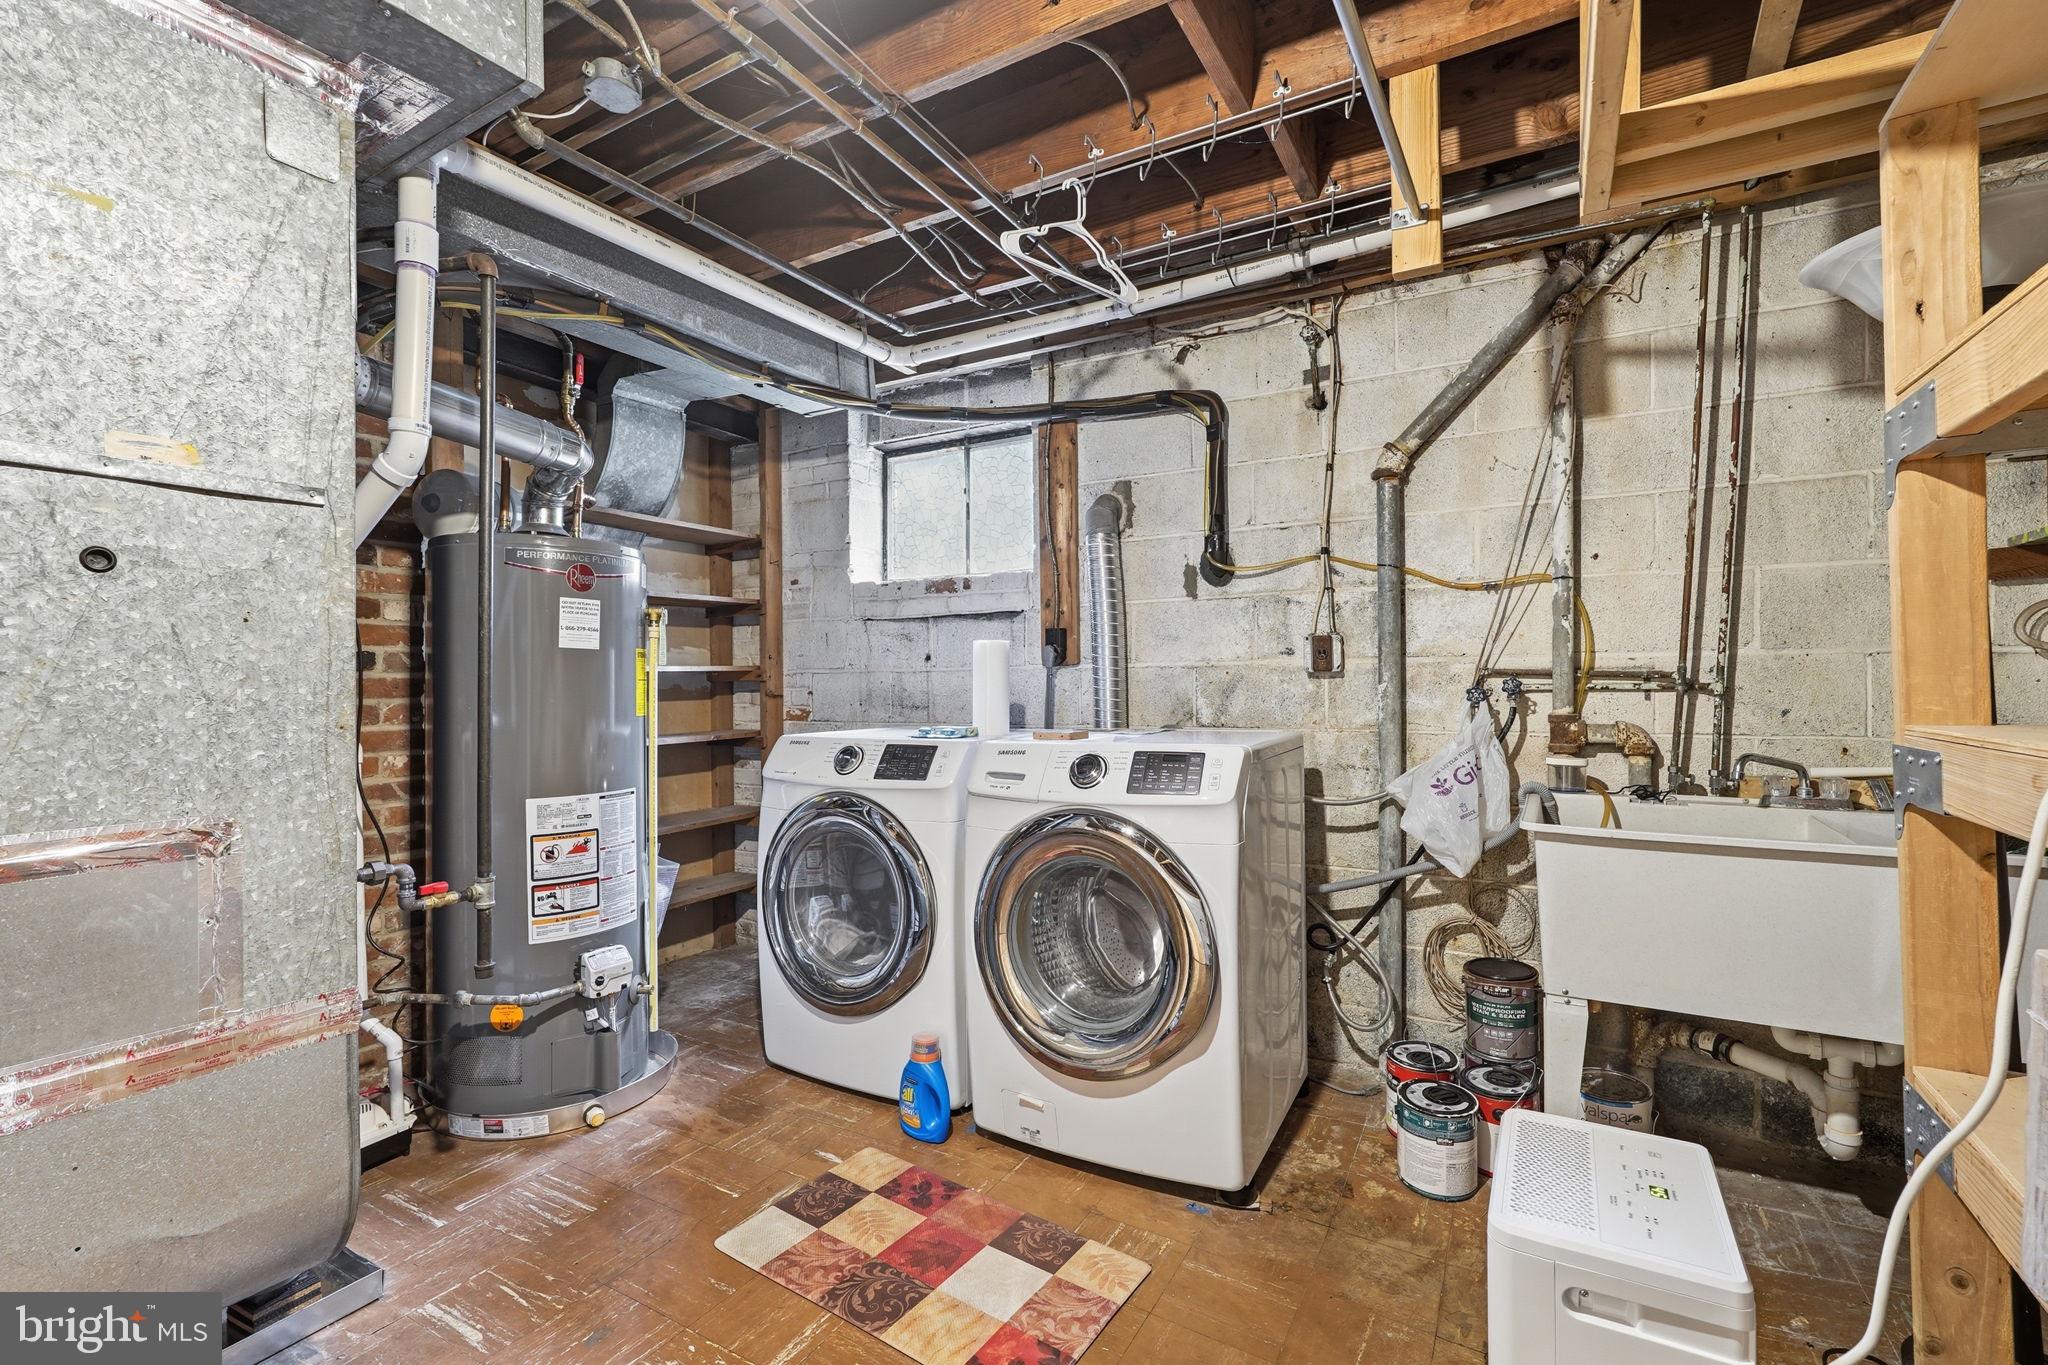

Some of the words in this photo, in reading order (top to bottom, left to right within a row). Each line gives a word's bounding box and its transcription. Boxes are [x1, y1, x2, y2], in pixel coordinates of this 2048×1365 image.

[516, 550, 592, 563] PERFORMANCE
[570, 564, 595, 587] Rheem
[1471, 1001, 1526, 1015] WATERPROOFING
[902, 1087, 914, 1102] all
